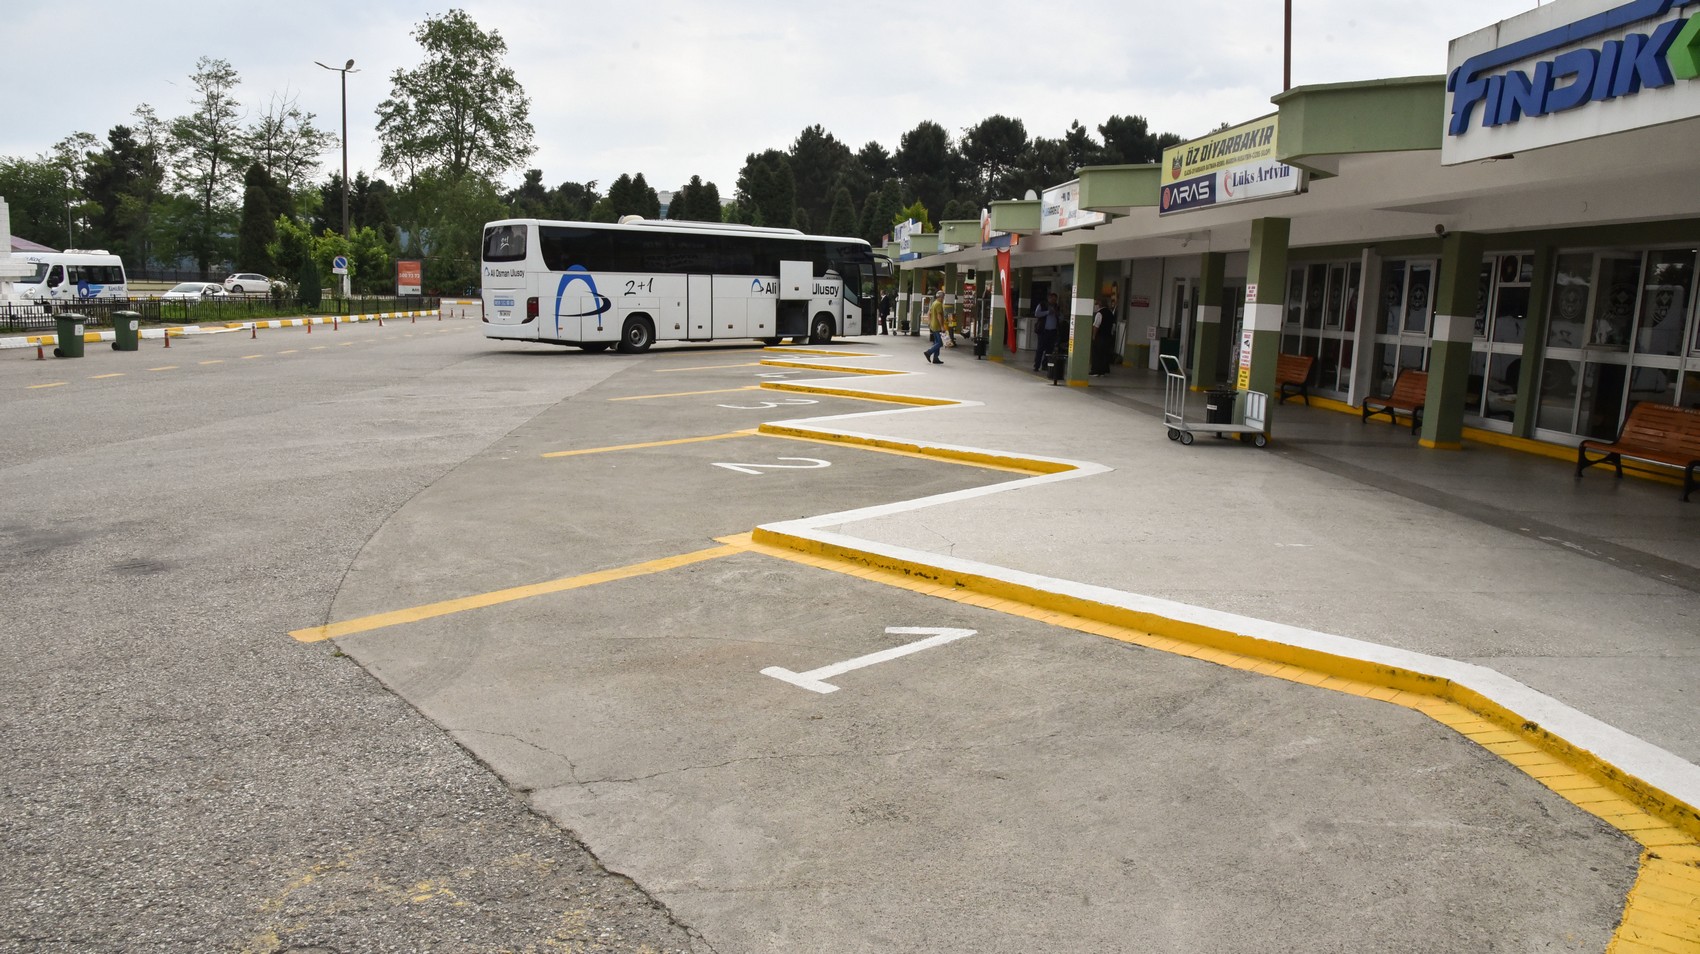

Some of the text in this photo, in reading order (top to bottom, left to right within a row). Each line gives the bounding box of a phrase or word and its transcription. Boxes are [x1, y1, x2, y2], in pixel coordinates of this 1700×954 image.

[1185, 147, 1200, 167] ÖZ
[1200, 125, 1275, 161] DİYARBAKIR
[1233, 163, 1291, 187] Lüks Artvin
[1170, 180, 1209, 205] ARAS
[496, 269, 510, 278] Osman
[510, 269, 525, 278] Ulusoy
[624, 277, 654, 296] 2+1
[765, 282, 839, 297] Ali Ulusoy
[711, 456, 832, 475] 2
[760, 626, 978, 694] 1
